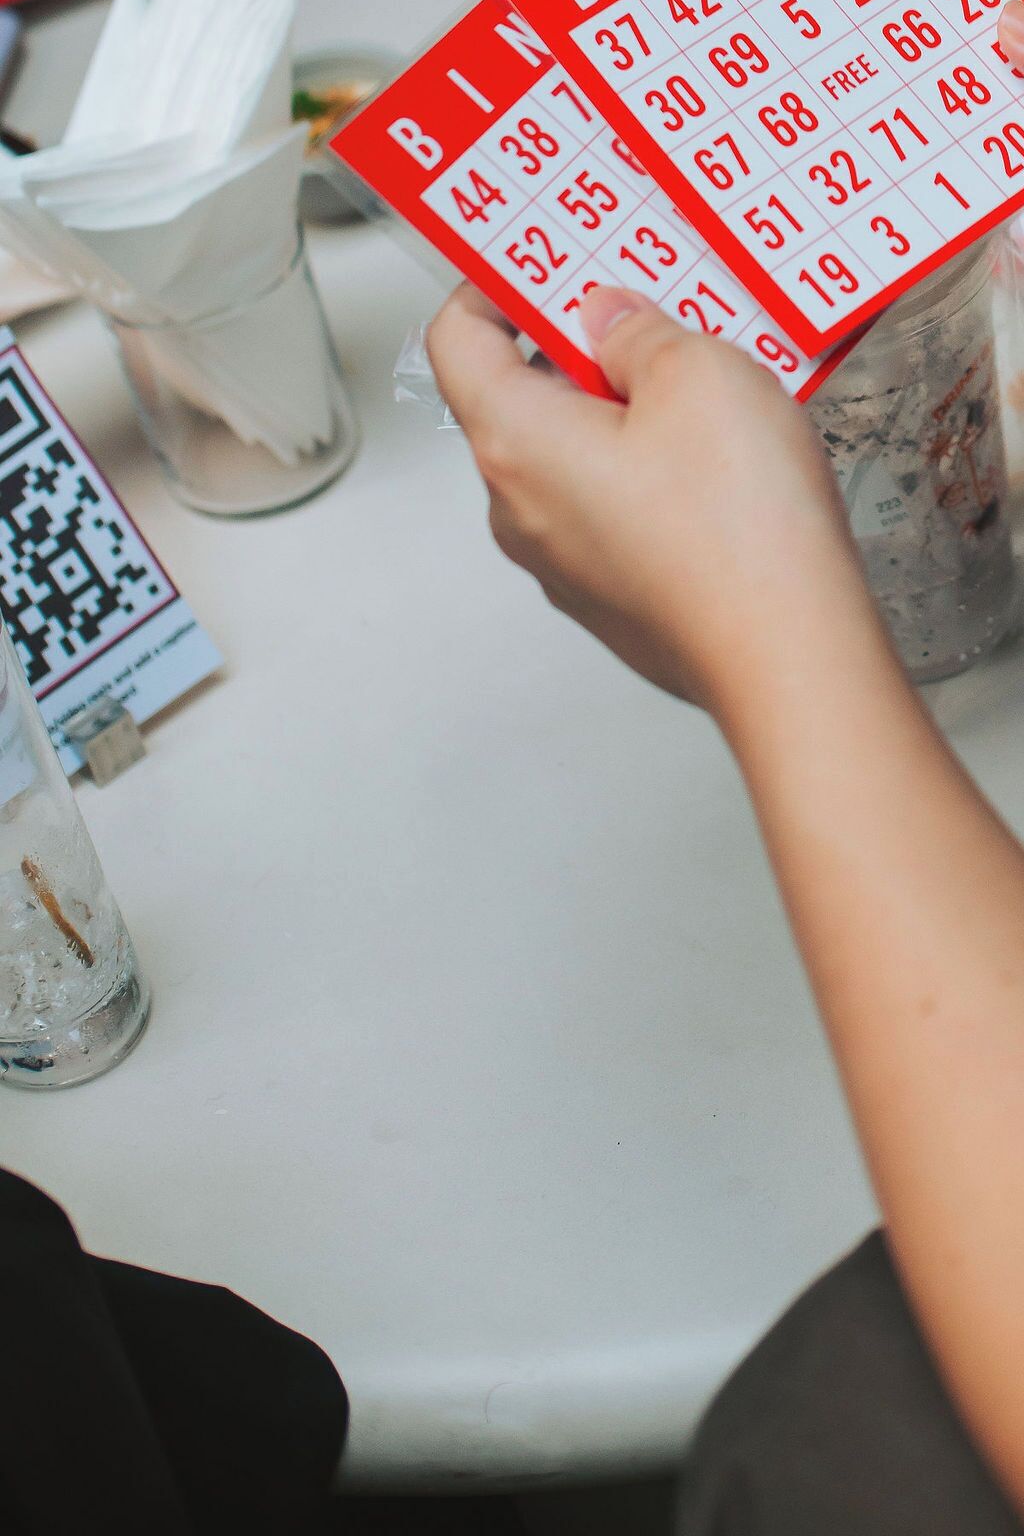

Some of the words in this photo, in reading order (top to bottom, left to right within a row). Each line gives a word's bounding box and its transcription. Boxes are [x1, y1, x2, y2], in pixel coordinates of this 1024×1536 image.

[594, 12, 652, 72] 37
[644, 75, 707, 132] 30
[708, 32, 770, 89] 69
[693, 132, 751, 191] 67
[757, 91, 820, 148] 68
[820, 53, 879, 101] FREE
[882, 8, 943, 63] 66
[450, 169, 508, 227] 44
[499, 117, 560, 176] 38
[743, 194, 805, 251] 51
[808, 149, 872, 206] 32
[868, 107, 930, 162] 71
[936, 65, 992, 116] 48
[504, 225, 569, 286] 52
[556, 170, 619, 231] 55
[619, 226, 679, 283] 13
[798, 252, 860, 308] 19
[869, 215, 911, 257] 3
[933, 172, 971, 211] 1
[677, 281, 737, 337] 21
